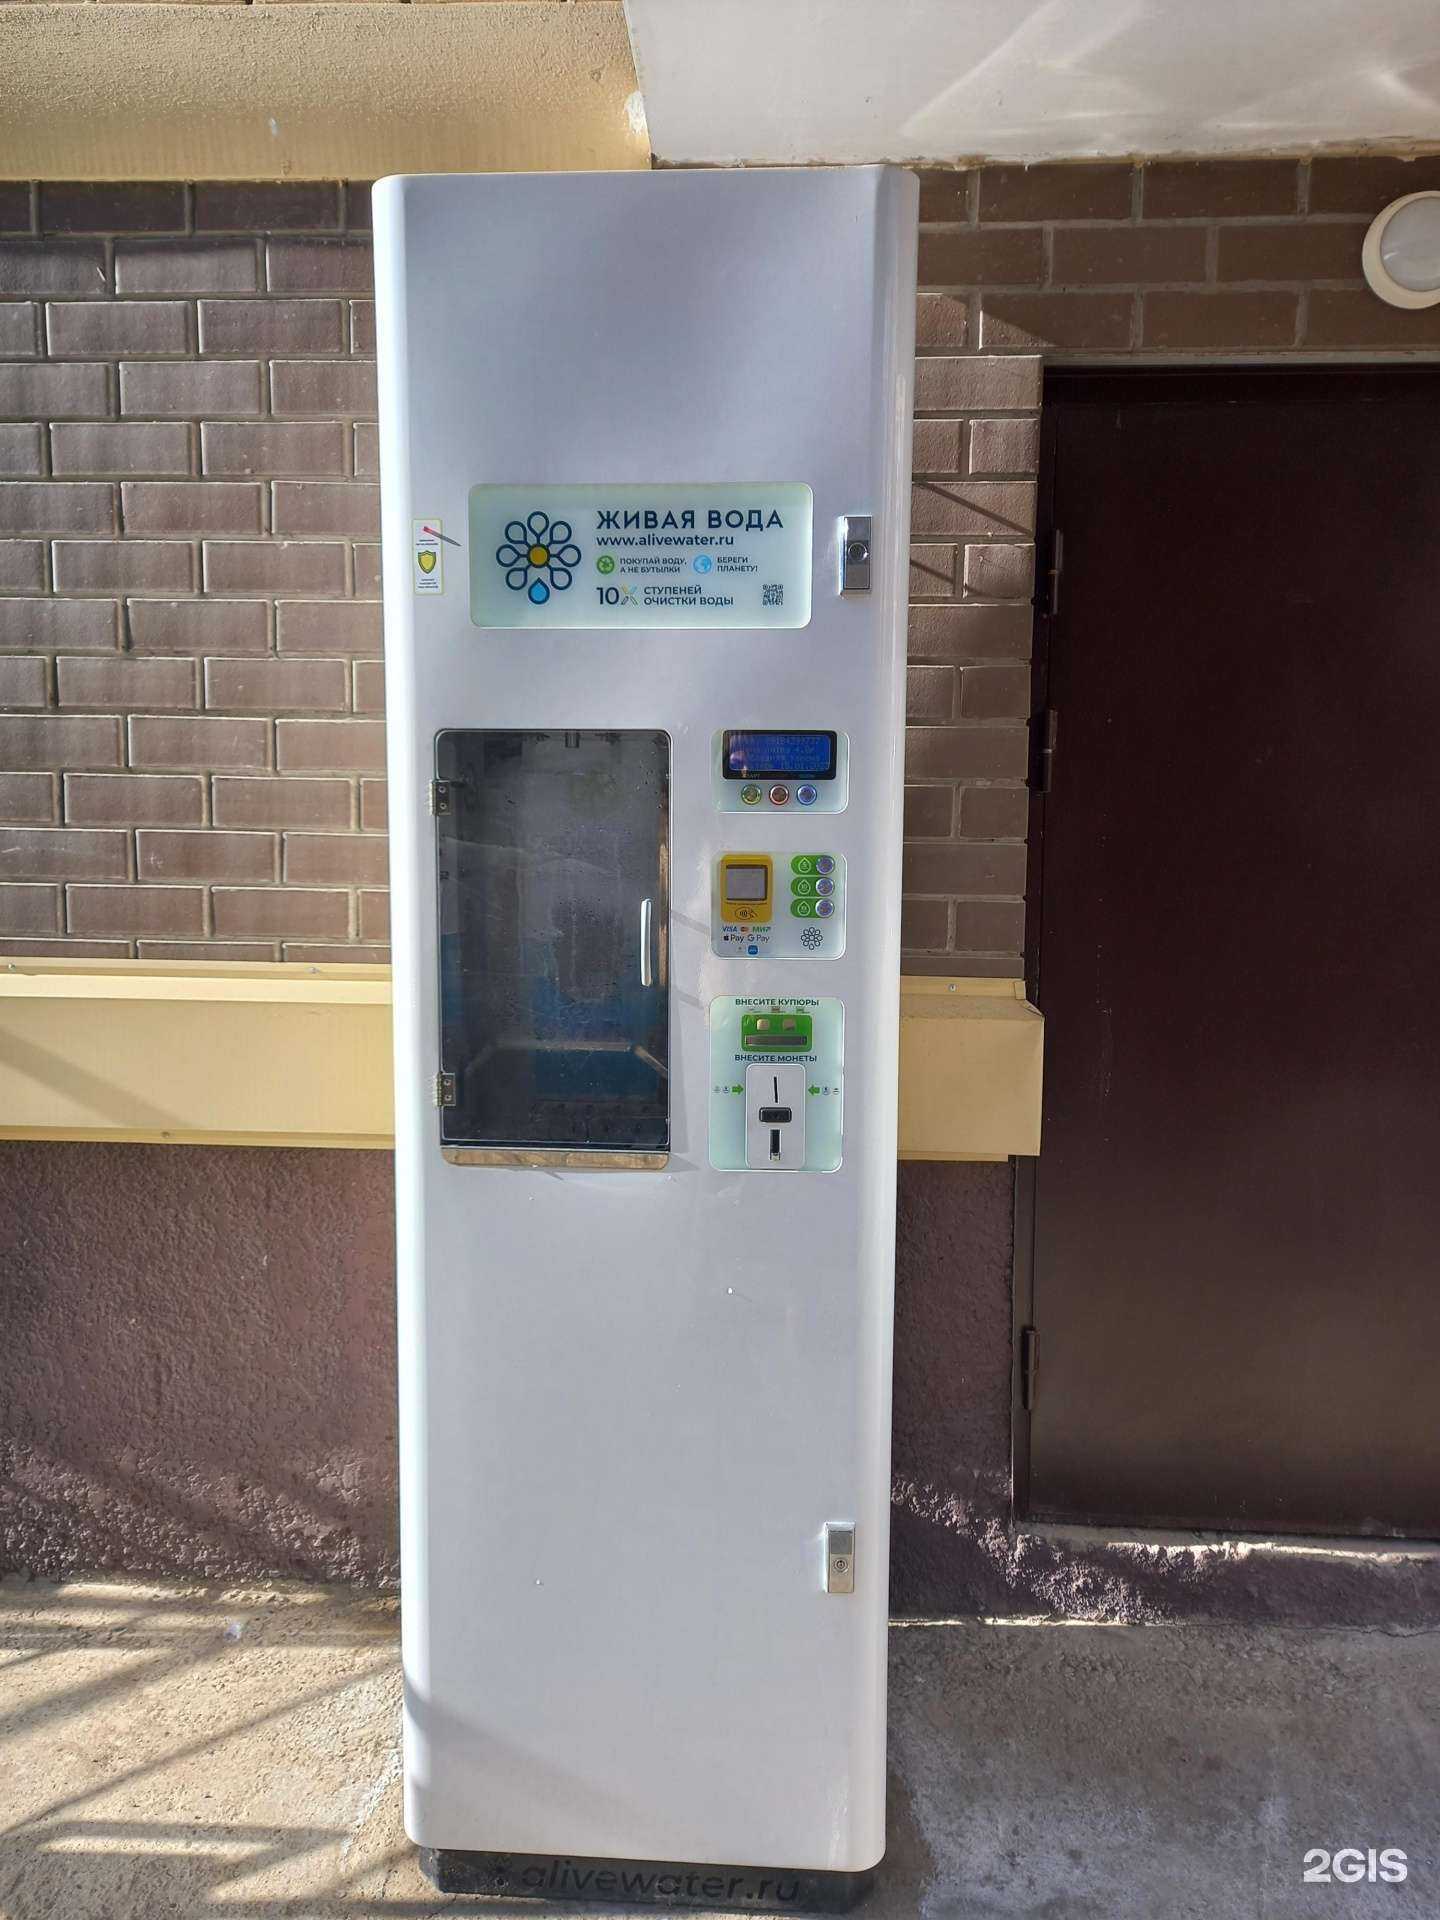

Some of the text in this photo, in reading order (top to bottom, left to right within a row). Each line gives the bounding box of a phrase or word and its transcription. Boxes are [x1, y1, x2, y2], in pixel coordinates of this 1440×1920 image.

[596, 509, 784, 532] ЖИВАЯ ВОДА
[596, 533, 734, 546] www.alivewater.ru
[620, 556, 687, 565] ПОКУПАЙ ВОДУ,
[717, 556, 748, 564] БЕРЕГИ
[640, 566, 680, 574] БУТЫЛКИ
[717, 565, 758, 573] ПЛАНЕТУ!
[643, 584, 702, 595] СТУПЕНЕЙ
[596, 587, 620, 605] 10
[643, 597, 734, 607] ОЧИСТКИ ВОДЫ
[730, 934, 744, 943] Pay
[735, 998, 776, 1006] ВНЕСИТЕ
[734, 1054, 776, 1062] ВНЕСИТЕ
[522, 1860, 799, 1901] alivewater.ru
